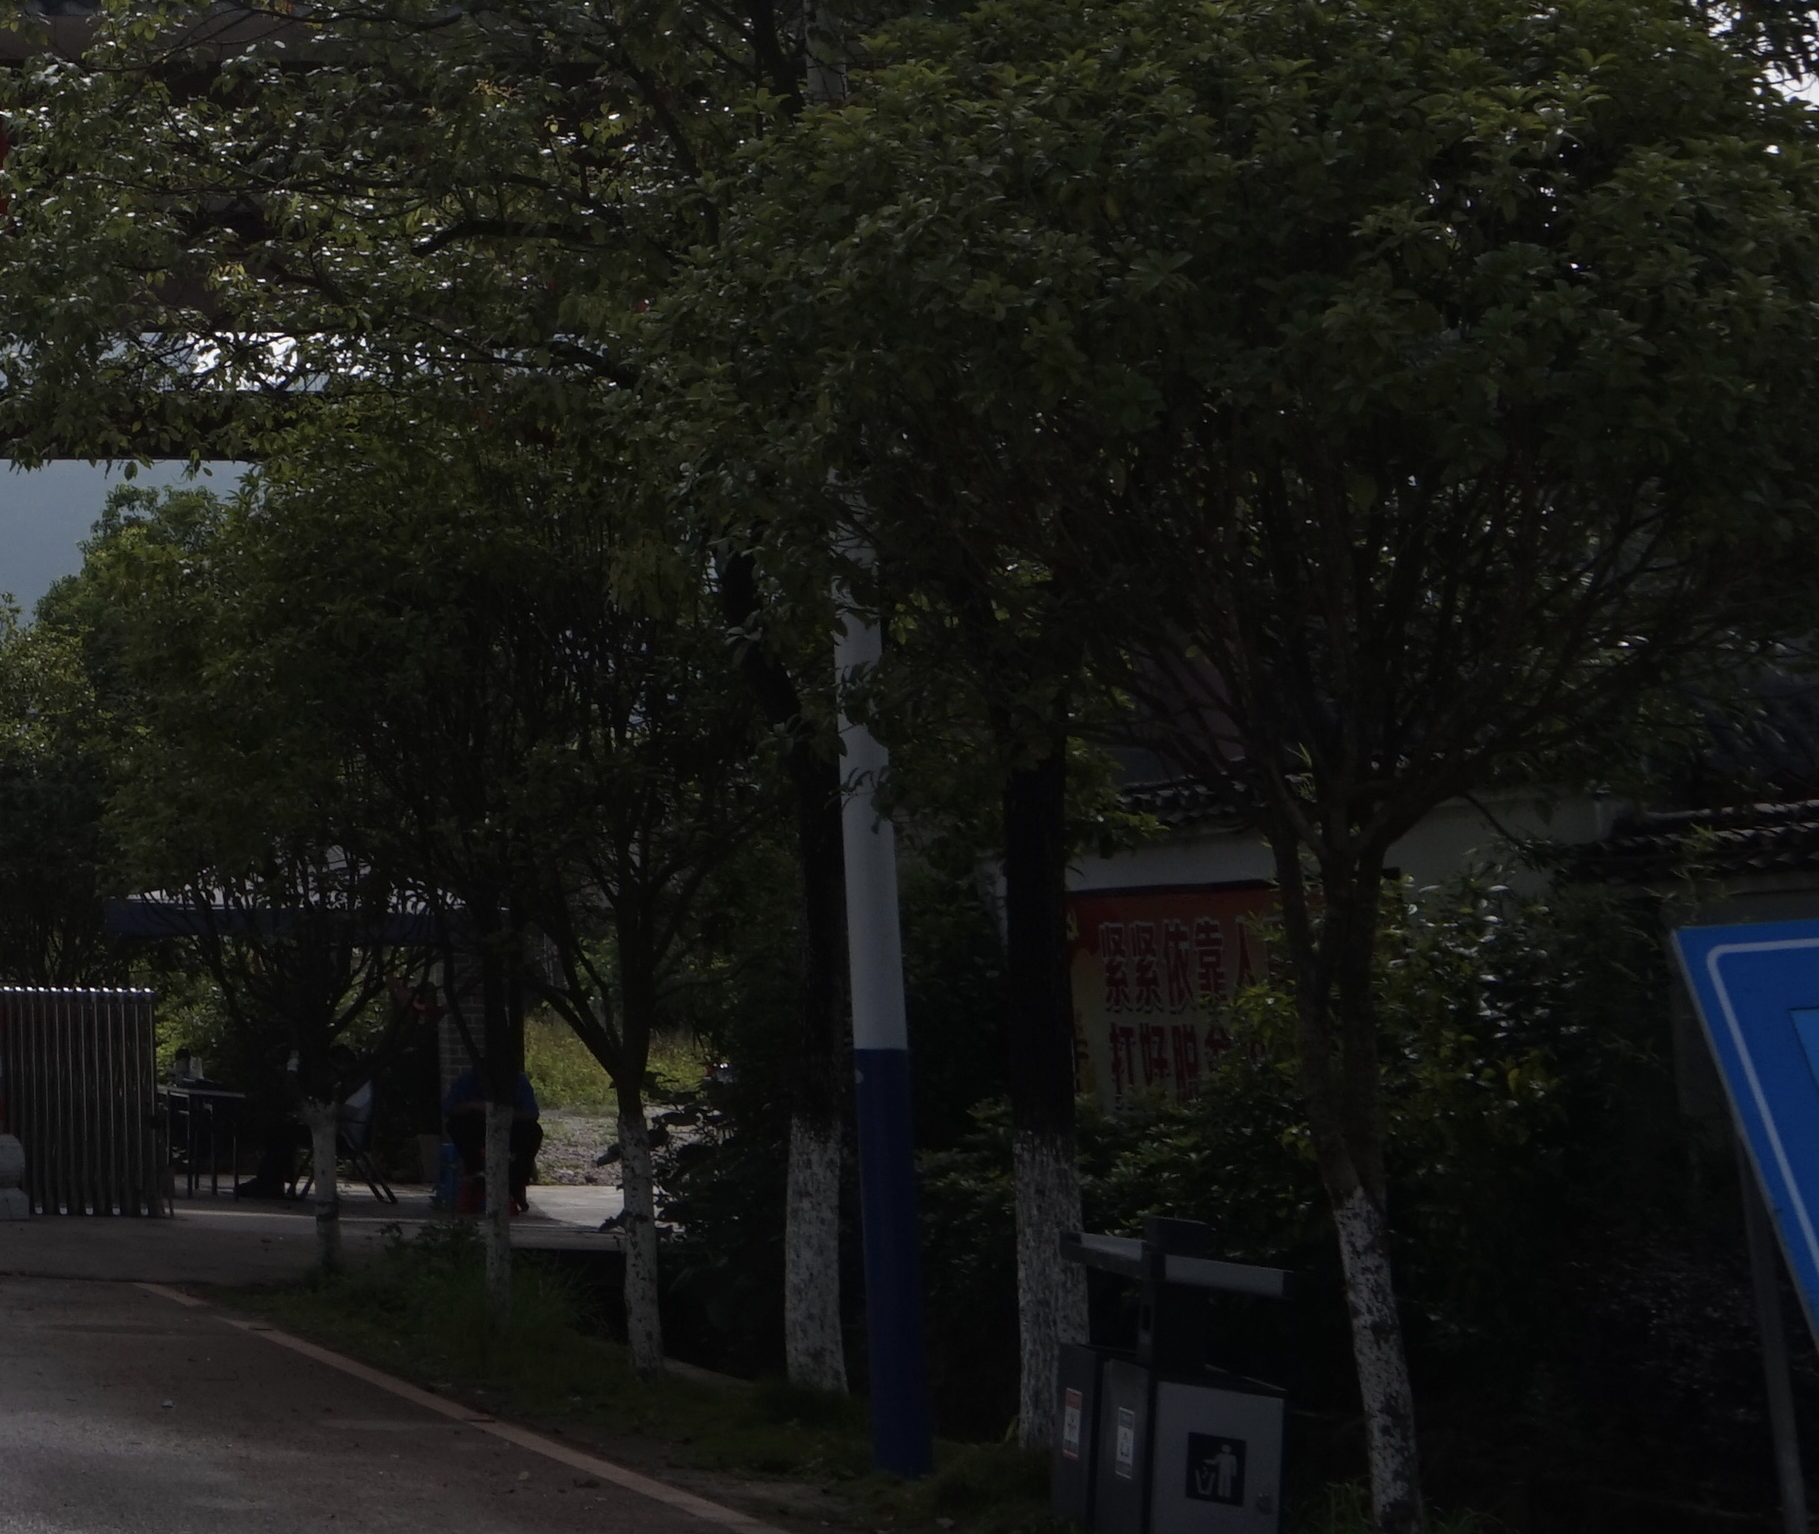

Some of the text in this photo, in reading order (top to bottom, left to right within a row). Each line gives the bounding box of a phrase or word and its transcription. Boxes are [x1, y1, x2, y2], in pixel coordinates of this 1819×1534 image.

[1099, 916, 1283, 1013] 紧紧依靠人
